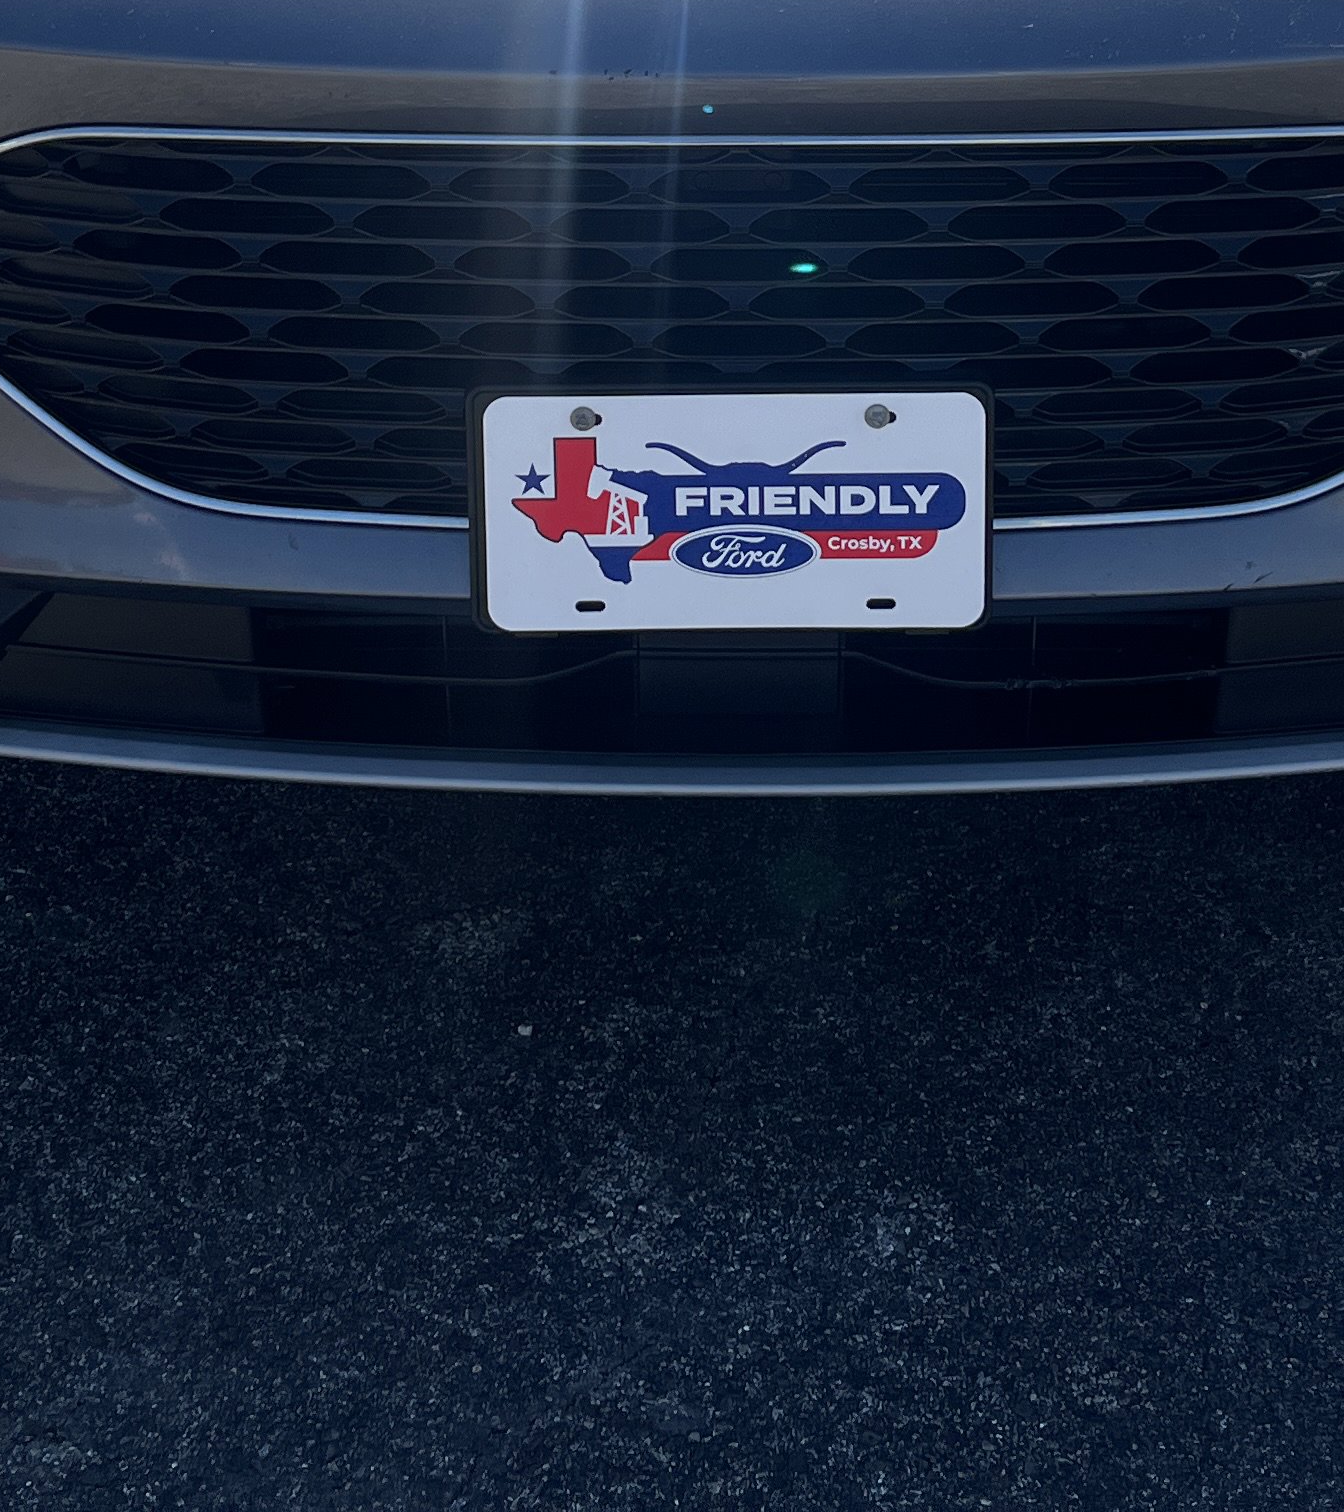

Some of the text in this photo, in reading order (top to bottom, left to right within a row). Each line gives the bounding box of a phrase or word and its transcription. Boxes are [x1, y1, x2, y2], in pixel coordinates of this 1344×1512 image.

[675, 484, 940, 516] FRIENDLY
[701, 534, 787, 569] Ford
[827, 535, 923, 554] Crosby, TX
